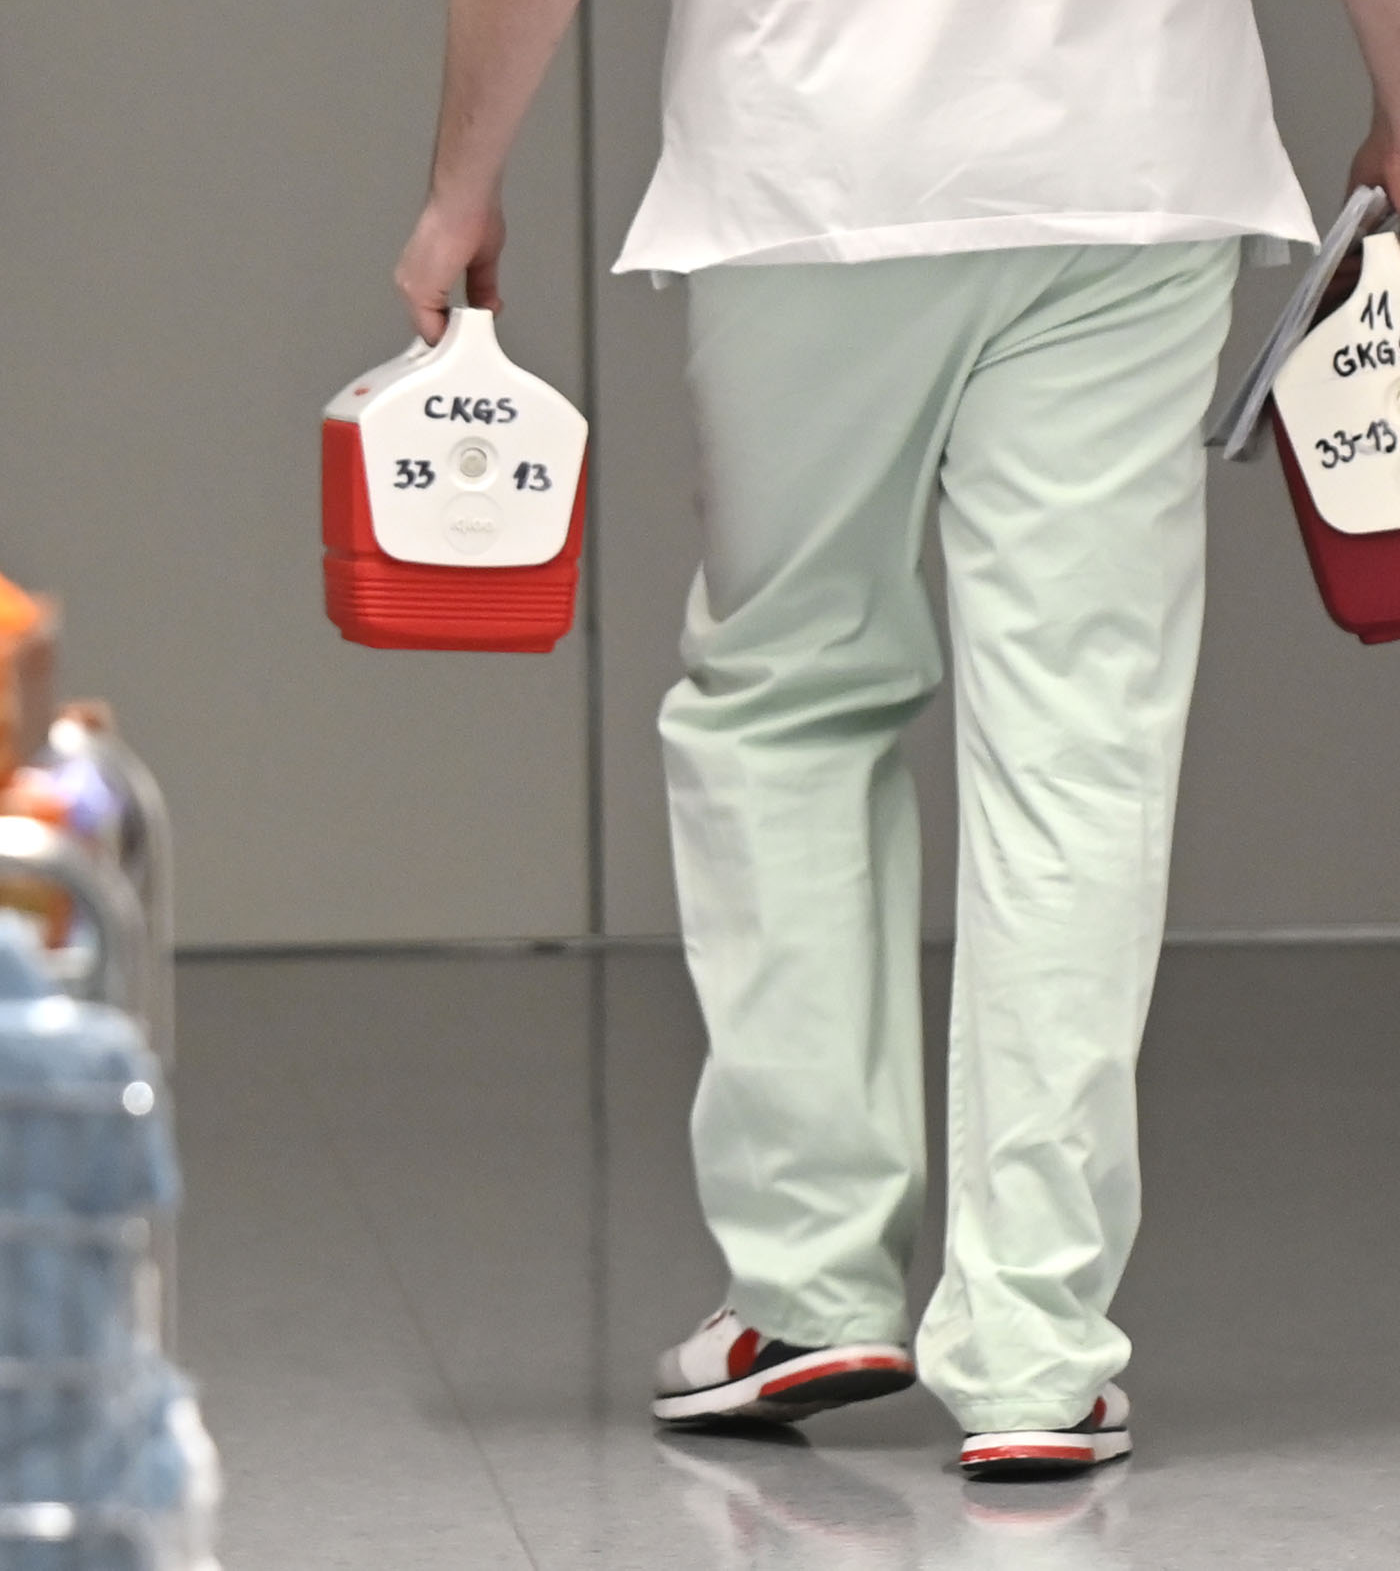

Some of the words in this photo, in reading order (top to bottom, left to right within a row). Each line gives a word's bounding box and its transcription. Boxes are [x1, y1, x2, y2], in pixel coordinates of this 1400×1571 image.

[1360, 290, 1393, 330] 11
[424, 395, 519, 425] CKGS
[1315, 418, 1398, 469] 33-13
[393, 458, 436, 489] 33
[512, 461, 553, 492] 13
